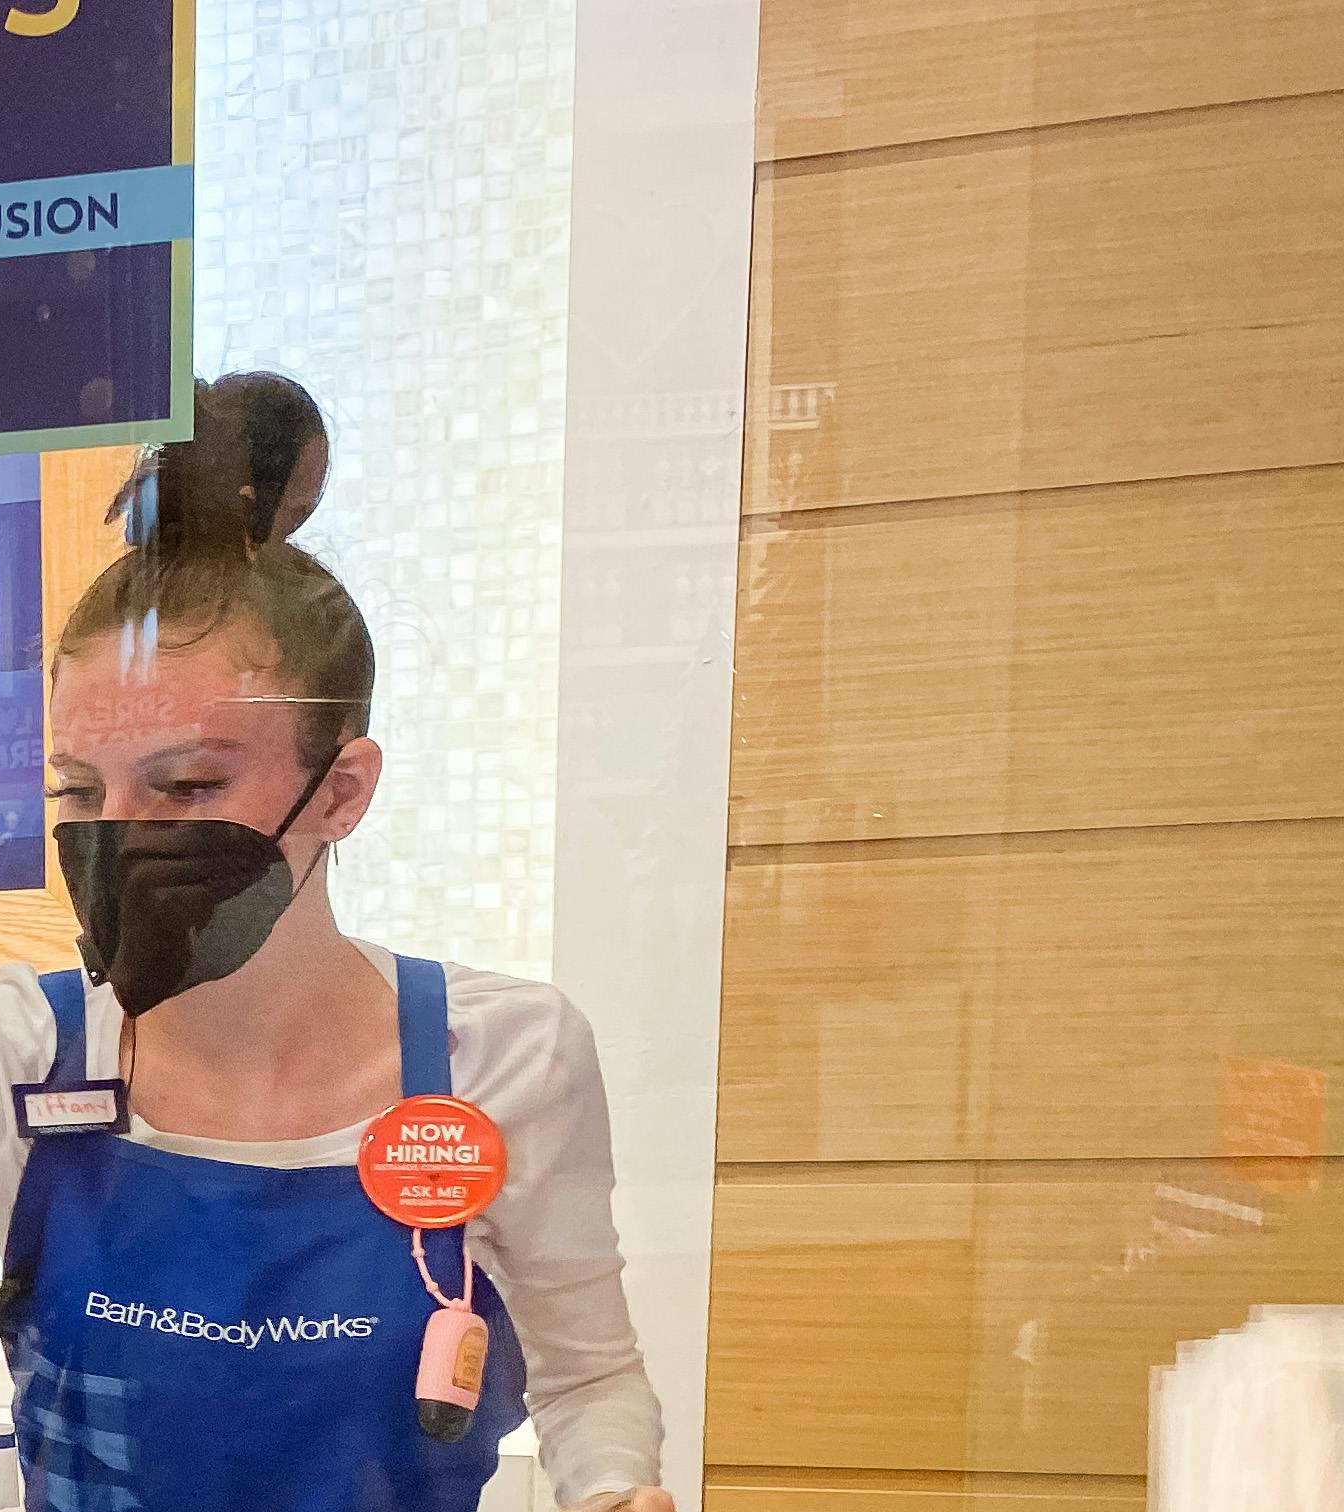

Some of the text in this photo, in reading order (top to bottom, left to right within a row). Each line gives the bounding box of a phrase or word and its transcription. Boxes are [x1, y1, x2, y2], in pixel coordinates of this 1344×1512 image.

[400, 1124, 466, 1142] NOW
[386, 1145, 480, 1163] HIRING!
[400, 1186, 467, 1198] ASK ME!
